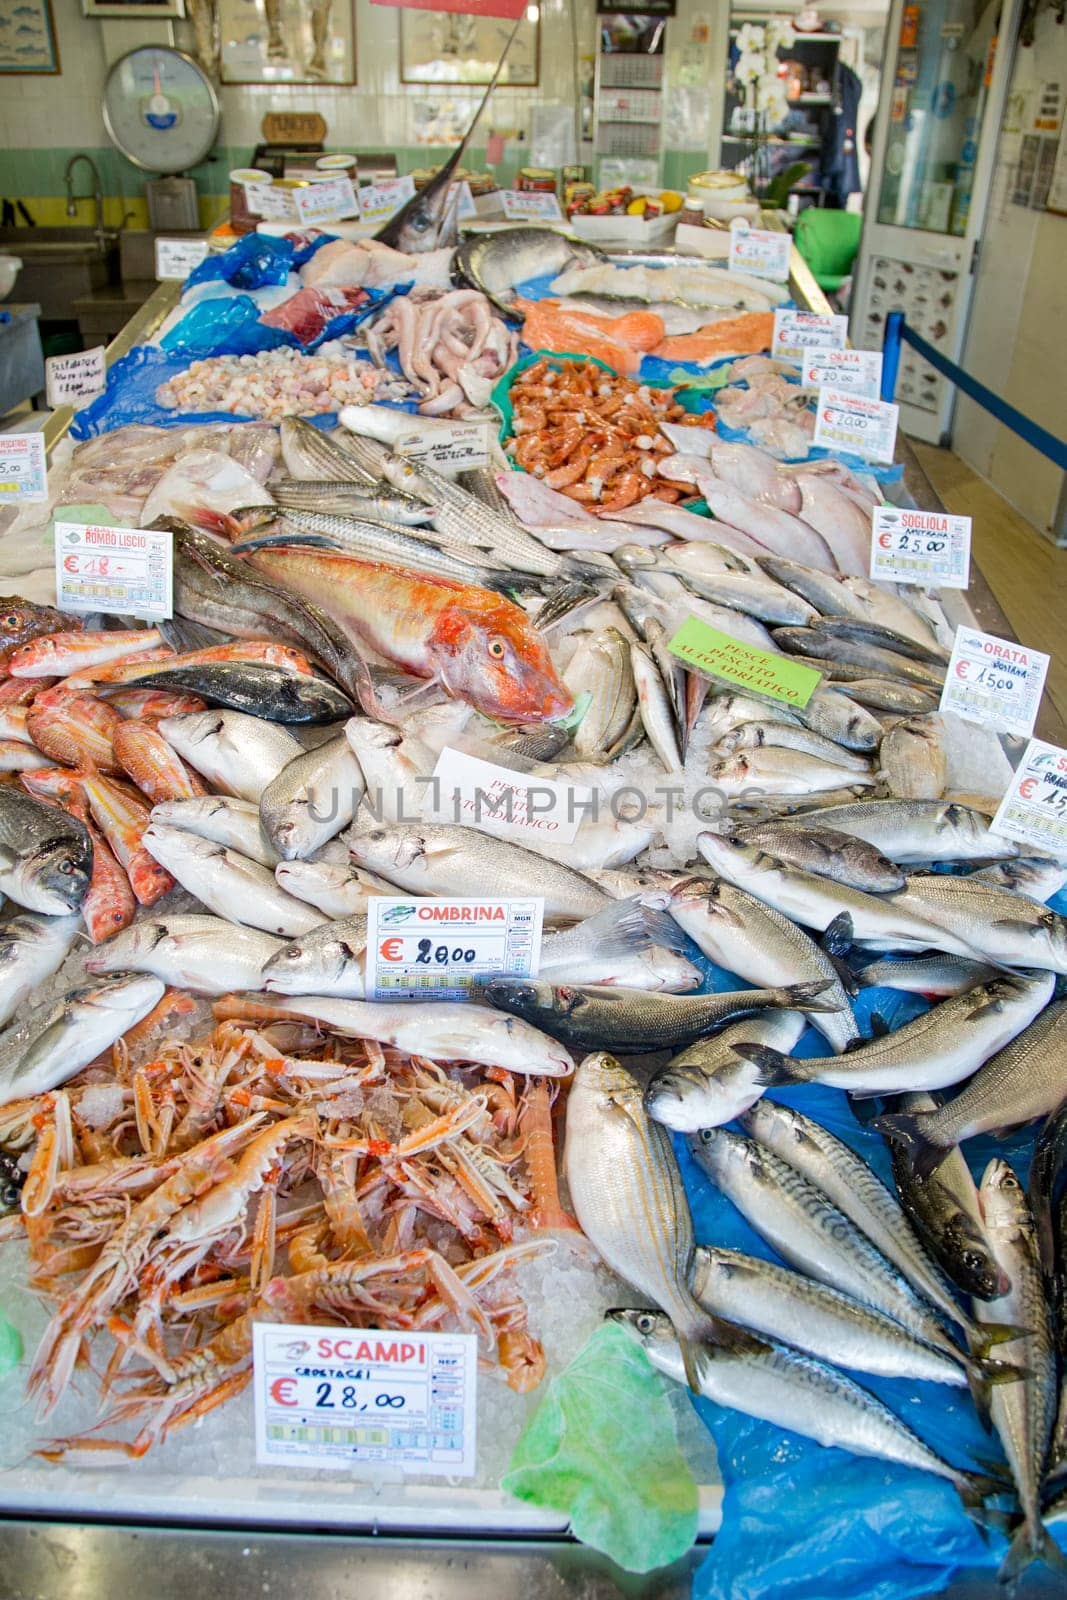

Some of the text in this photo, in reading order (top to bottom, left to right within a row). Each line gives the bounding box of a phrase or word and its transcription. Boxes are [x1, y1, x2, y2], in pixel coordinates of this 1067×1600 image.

[829, 353, 860, 363] ORATA
[808, 368, 819, 381] €
[823, 409, 834, 424] €
[901, 513, 948, 531] SOGLIOLA
[85, 532, 146, 548] ROMBO LISCIO
[879, 532, 893, 548] €
[64, 555, 80, 574] €
[708, 648, 776, 679] PESCATO
[723, 643, 771, 667] PESCE
[983, 642, 1028, 666] ORATA
[676, 644, 800, 699] ALTO ADRIATICO
[955, 659, 971, 679] €
[1019, 777, 1040, 799] €
[418, 905, 506, 922] OMBRINA
[379, 937, 404, 962] €
[317, 1338, 426, 1364] SCAMPI
[269, 1377, 299, 1407] €
[315, 1381, 406, 1411] 28,00
